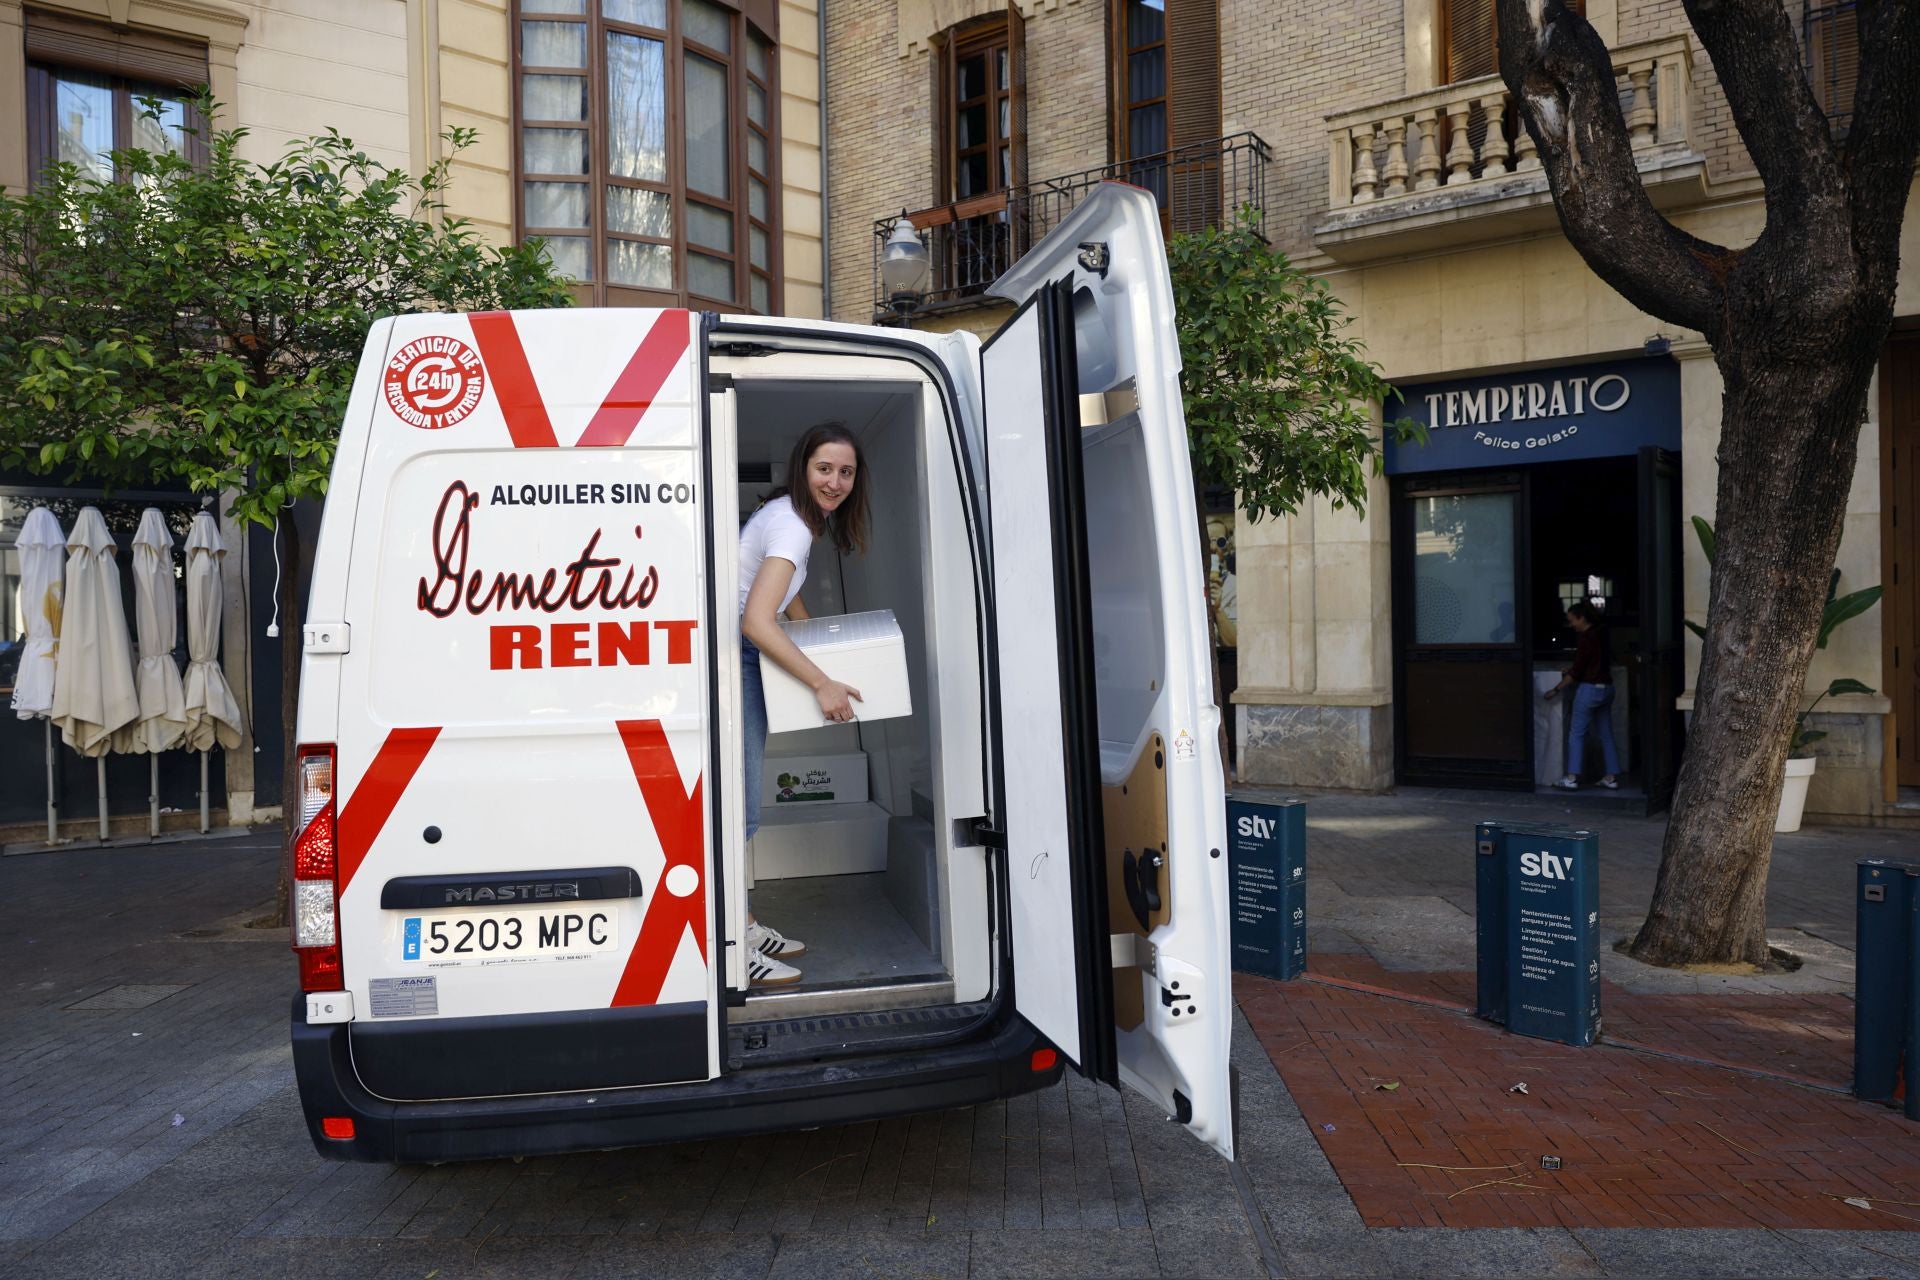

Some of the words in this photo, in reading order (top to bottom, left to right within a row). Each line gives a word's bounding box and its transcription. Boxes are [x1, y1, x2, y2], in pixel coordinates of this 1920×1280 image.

[390, 337, 460, 372] SERVICIO
[458, 349, 480, 370] DE
[417, 372, 452, 390] 24h
[387, 382, 431, 428] RECOGIDA
[434, 414, 443, 428] Y
[444, 376, 481, 425] ENTREGA
[1425, 374, 1630, 429] TEMPERATO
[1473, 431, 1520, 450] Felice
[1525, 425, 1578, 449] Gelato
[490, 484, 605, 506] ALQUILER
[610, 483, 651, 504] SIN
[657, 483, 696, 504] CO
[417, 480, 659, 619] Demetrio
[489, 620, 698, 671] RENT
[1237, 814, 1276, 840] stv
[1520, 851, 1573, 880] stv
[445, 881, 579, 903] MASTER
[1521, 909, 1562, 921] Mantenimiento
[1521, 917, 1544, 925] parques
[429, 917, 523, 954] 5203
[538, 913, 609, 948] MPC
[1521, 927, 1547, 936] Limpieza
[1551, 932, 1577, 941] recogida
[407, 943, 416, 954] E
[1521, 954, 1552, 963] suministro
[1521, 964, 1547, 973] Limpieza
[1547, 967, 1556, 975] de
[1522, 1004, 1566, 1017] stvgestion.com
